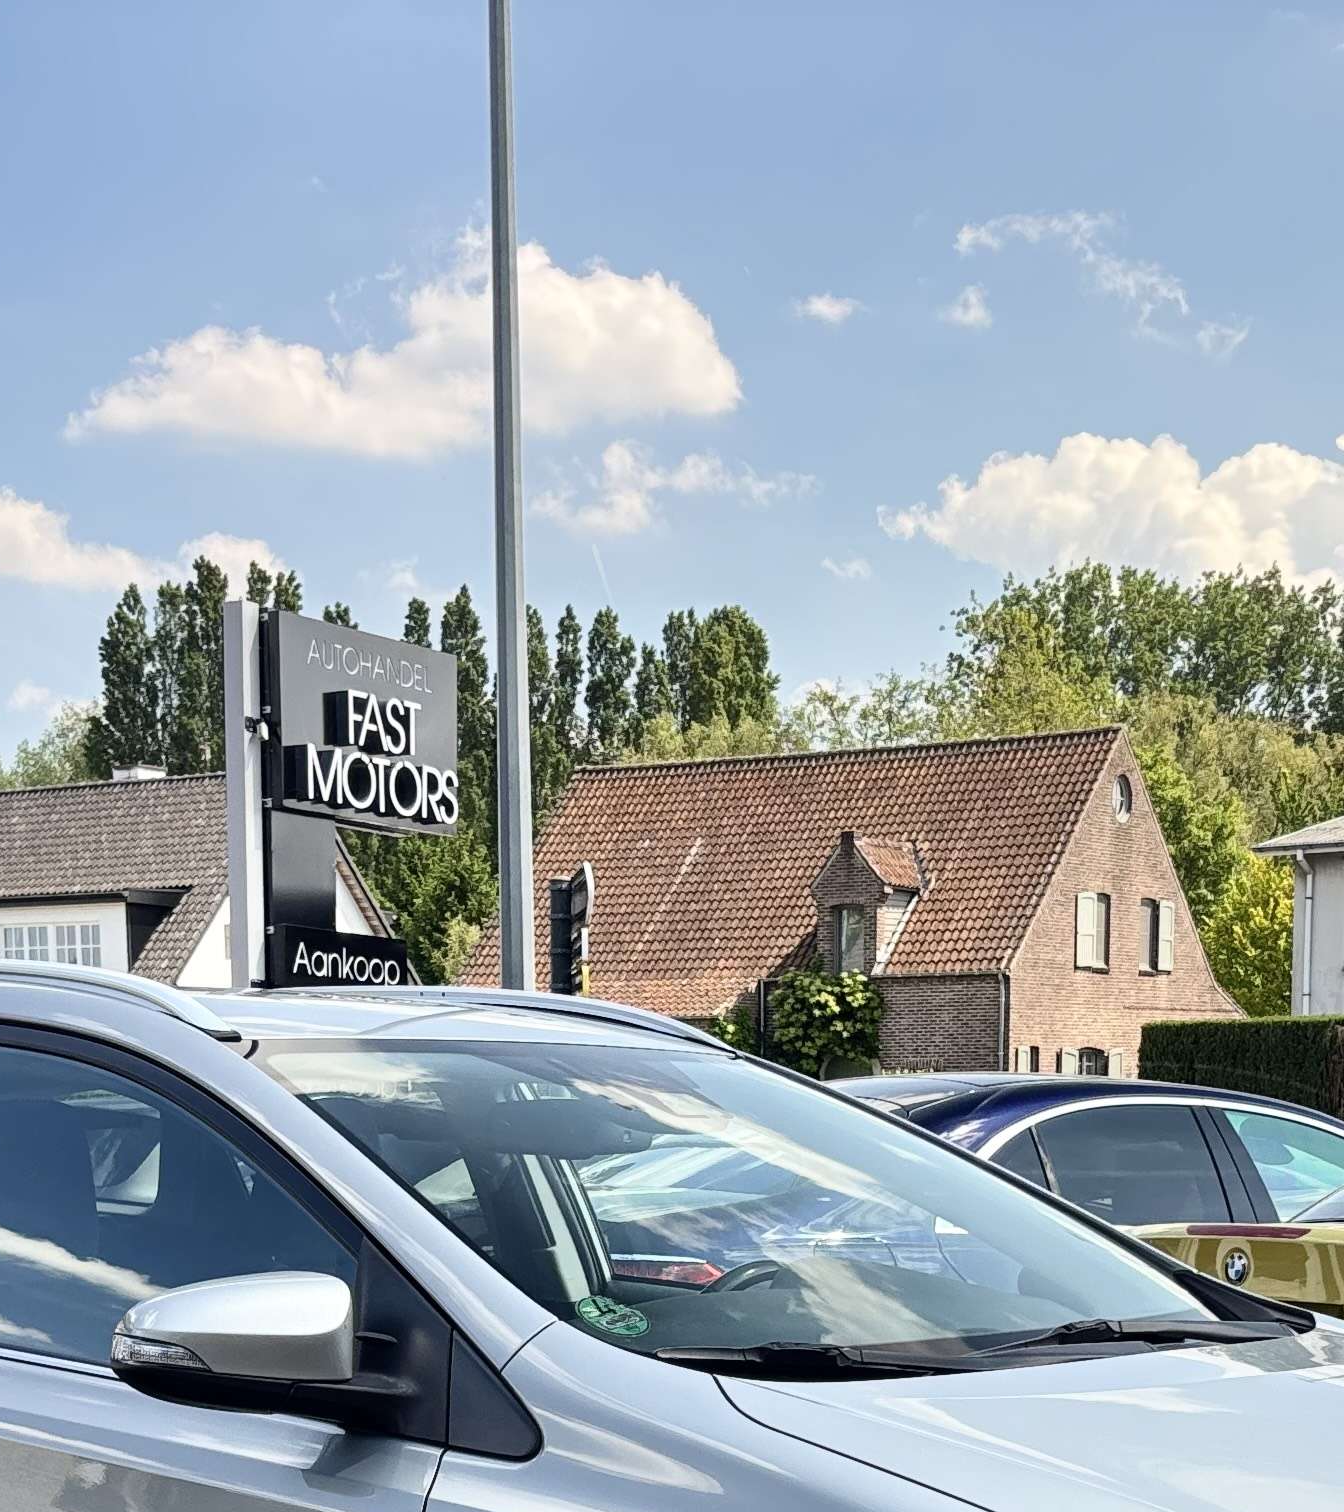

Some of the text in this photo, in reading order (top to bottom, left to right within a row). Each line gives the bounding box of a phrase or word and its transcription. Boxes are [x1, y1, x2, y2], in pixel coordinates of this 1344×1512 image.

[307, 638, 433, 694] AUTOHANDEL
[347, 689, 422, 756] FAST
[306, 742, 459, 825] MOTORS
[293, 941, 401, 985] Aankoop
